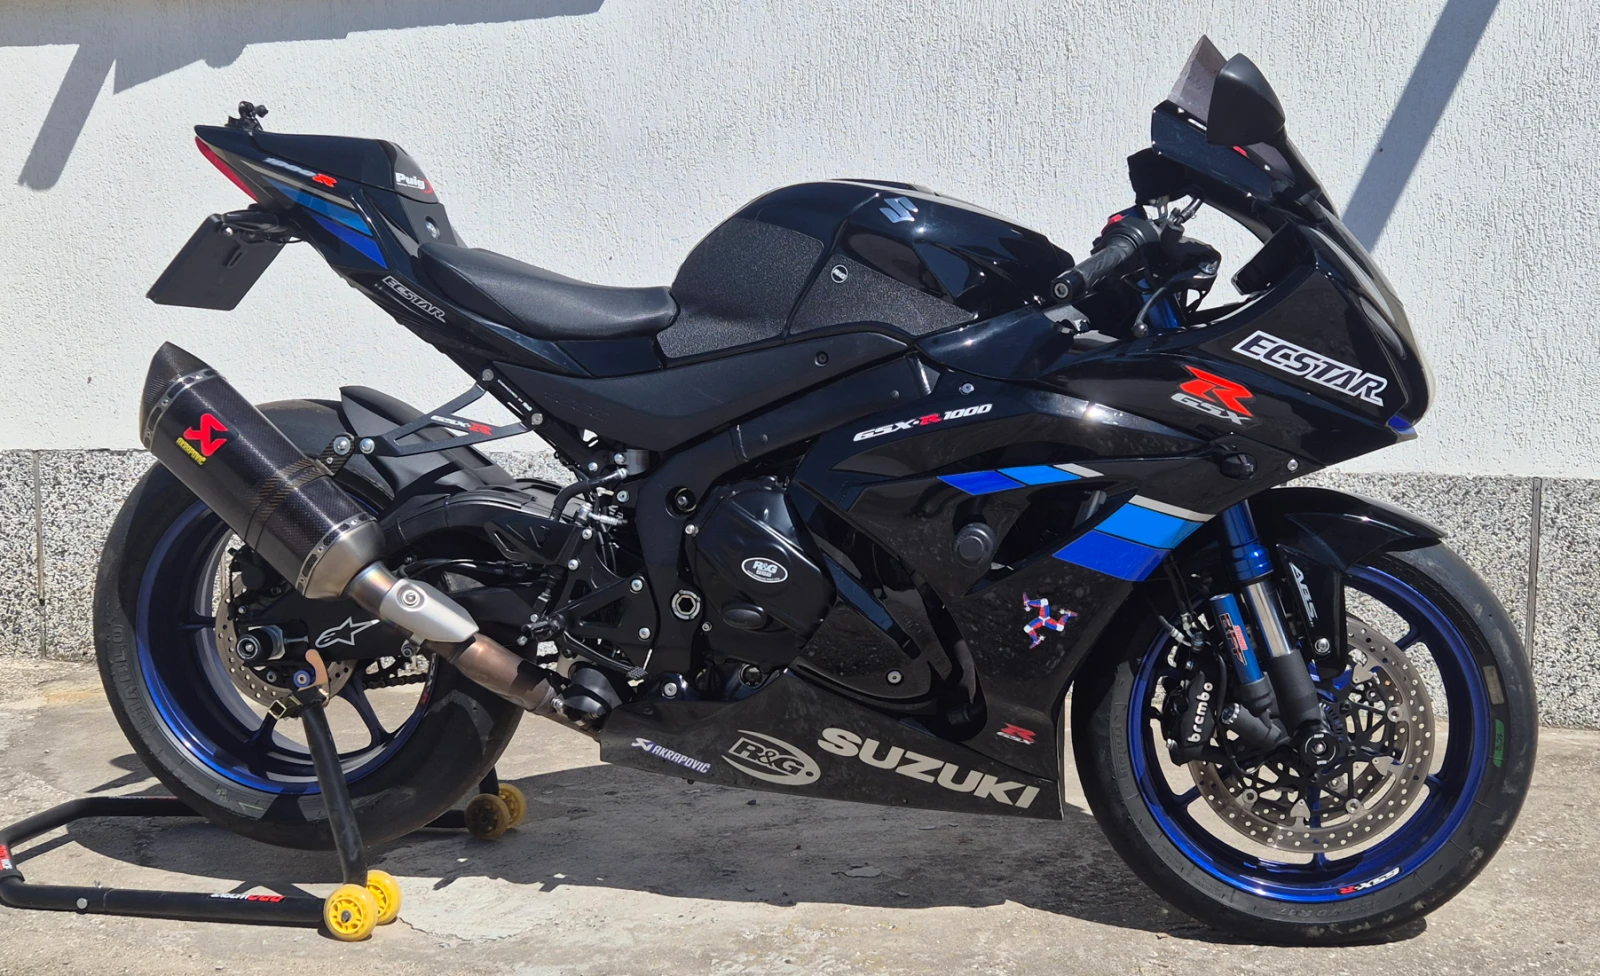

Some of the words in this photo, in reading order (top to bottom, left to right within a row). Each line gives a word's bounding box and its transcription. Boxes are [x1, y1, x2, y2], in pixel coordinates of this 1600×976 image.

[395, 172, 425, 190] Puig
[382, 275, 446, 323] ECSTAR
[1232, 330, 1388, 407] ECSTAR
[1171, 392, 1251, 425] GSX
[752, 560, 778, 574] R&G
[1289, 562, 1318, 622] ABS
[1187, 682, 1213, 743] brembo
[727, 736, 806, 776] R&G
[817, 727, 1041, 809] SUZUKI
